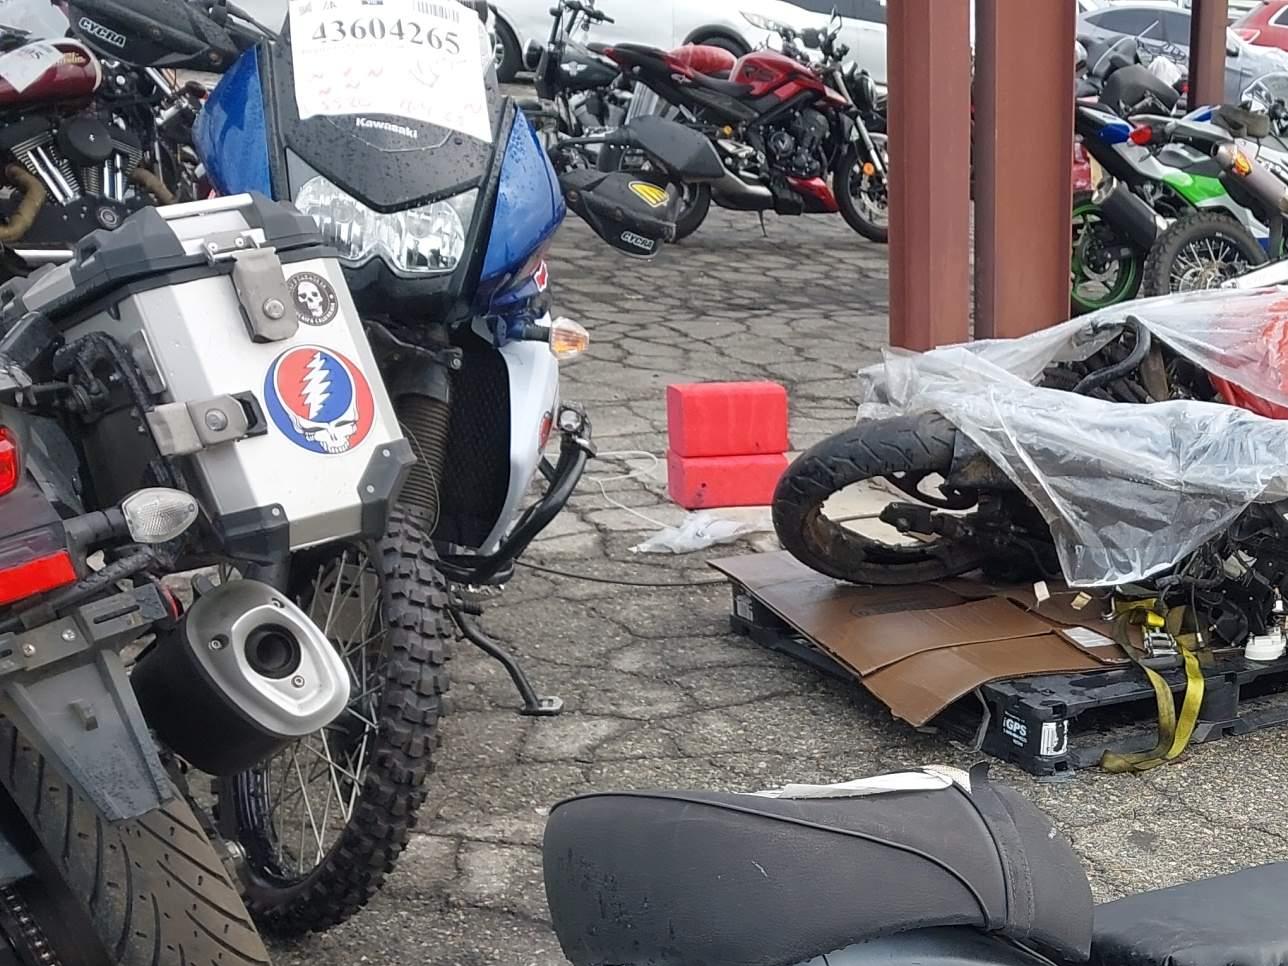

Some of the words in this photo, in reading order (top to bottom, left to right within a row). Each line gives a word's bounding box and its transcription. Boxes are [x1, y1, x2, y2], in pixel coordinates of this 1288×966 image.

[79, 16, 127, 49] CYCRA
[312, 17, 461, 55] 43604265
[355, 117, 419, 139] Kawasaki
[620, 230, 655, 251] CYCRA
